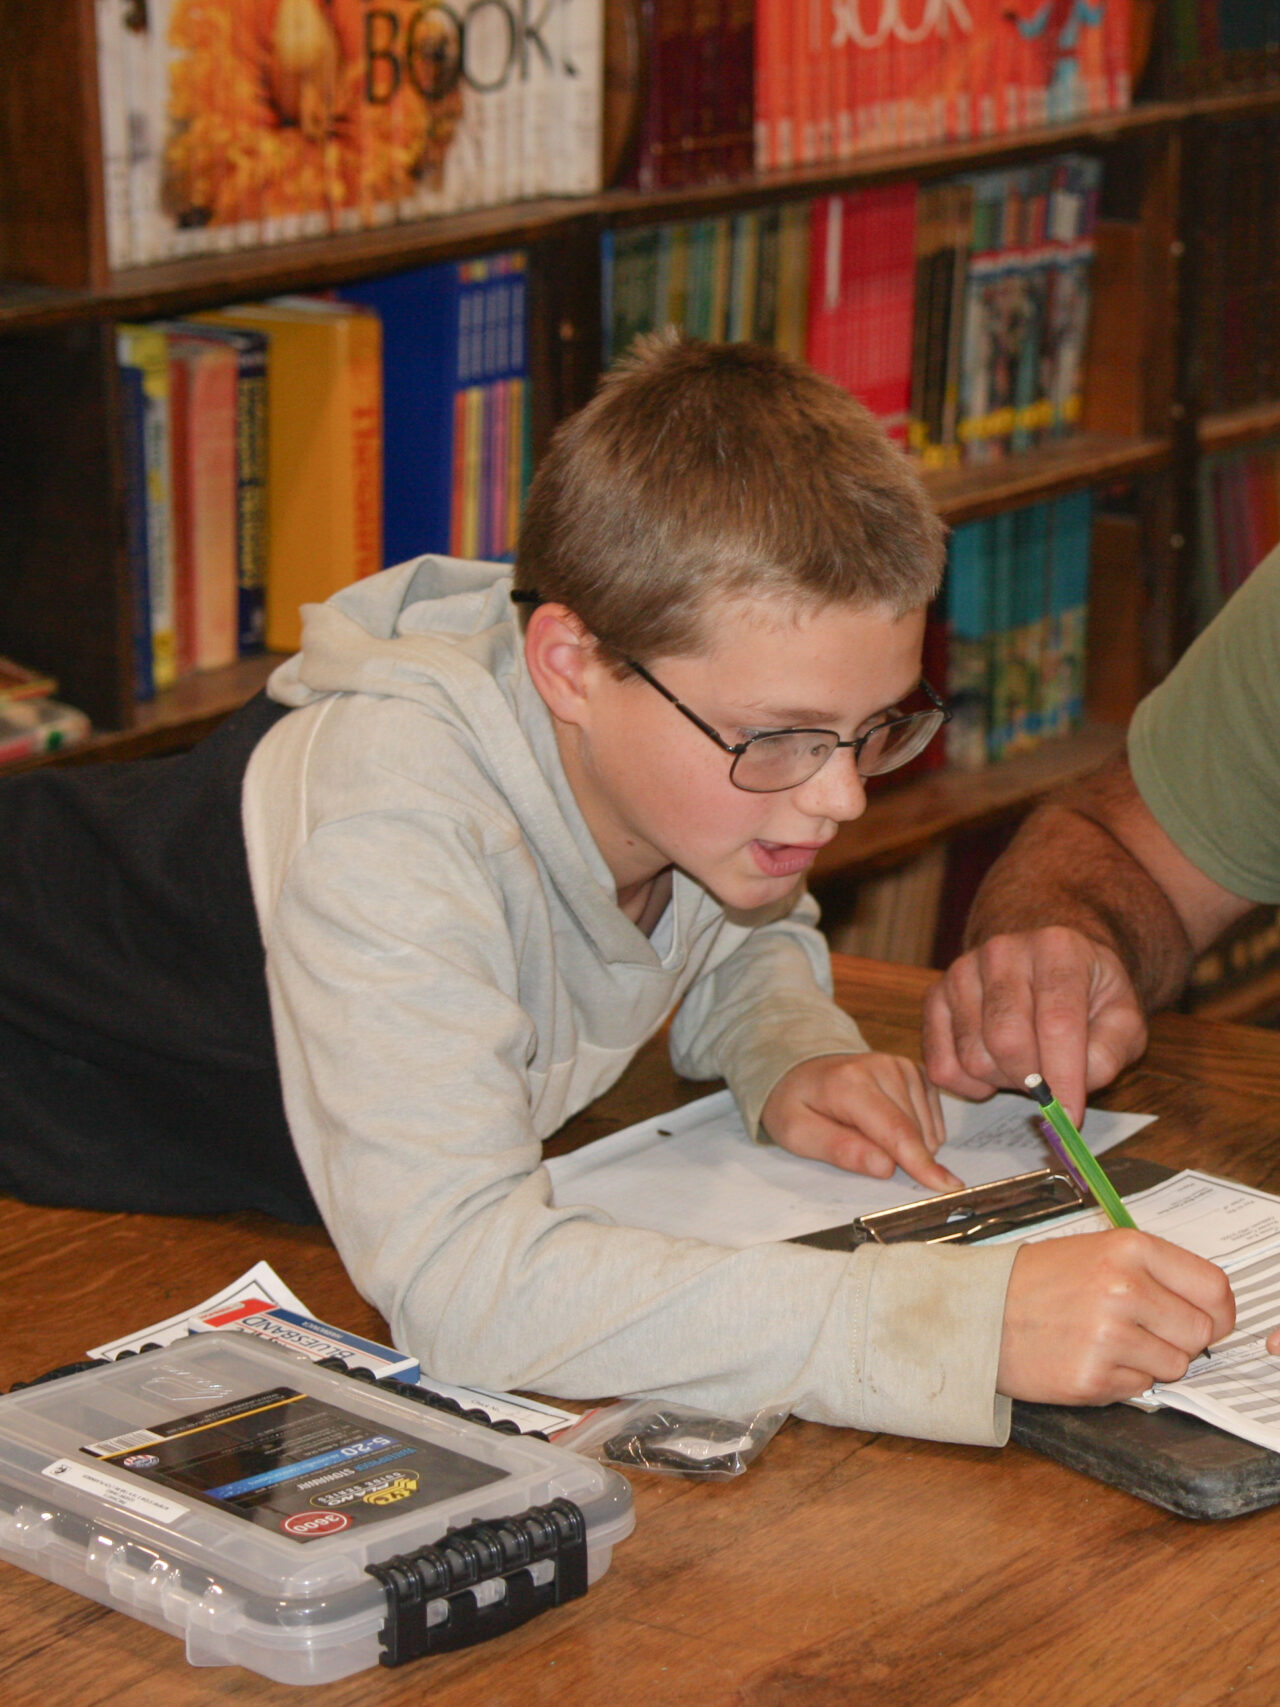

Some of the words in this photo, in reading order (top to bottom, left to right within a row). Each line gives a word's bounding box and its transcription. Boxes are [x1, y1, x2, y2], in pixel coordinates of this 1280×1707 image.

[242, 1316, 355, 1360] BLUESBAND
[340, 1436, 392, 1457] 5-20
[292, 1514, 341, 1533] 3600
